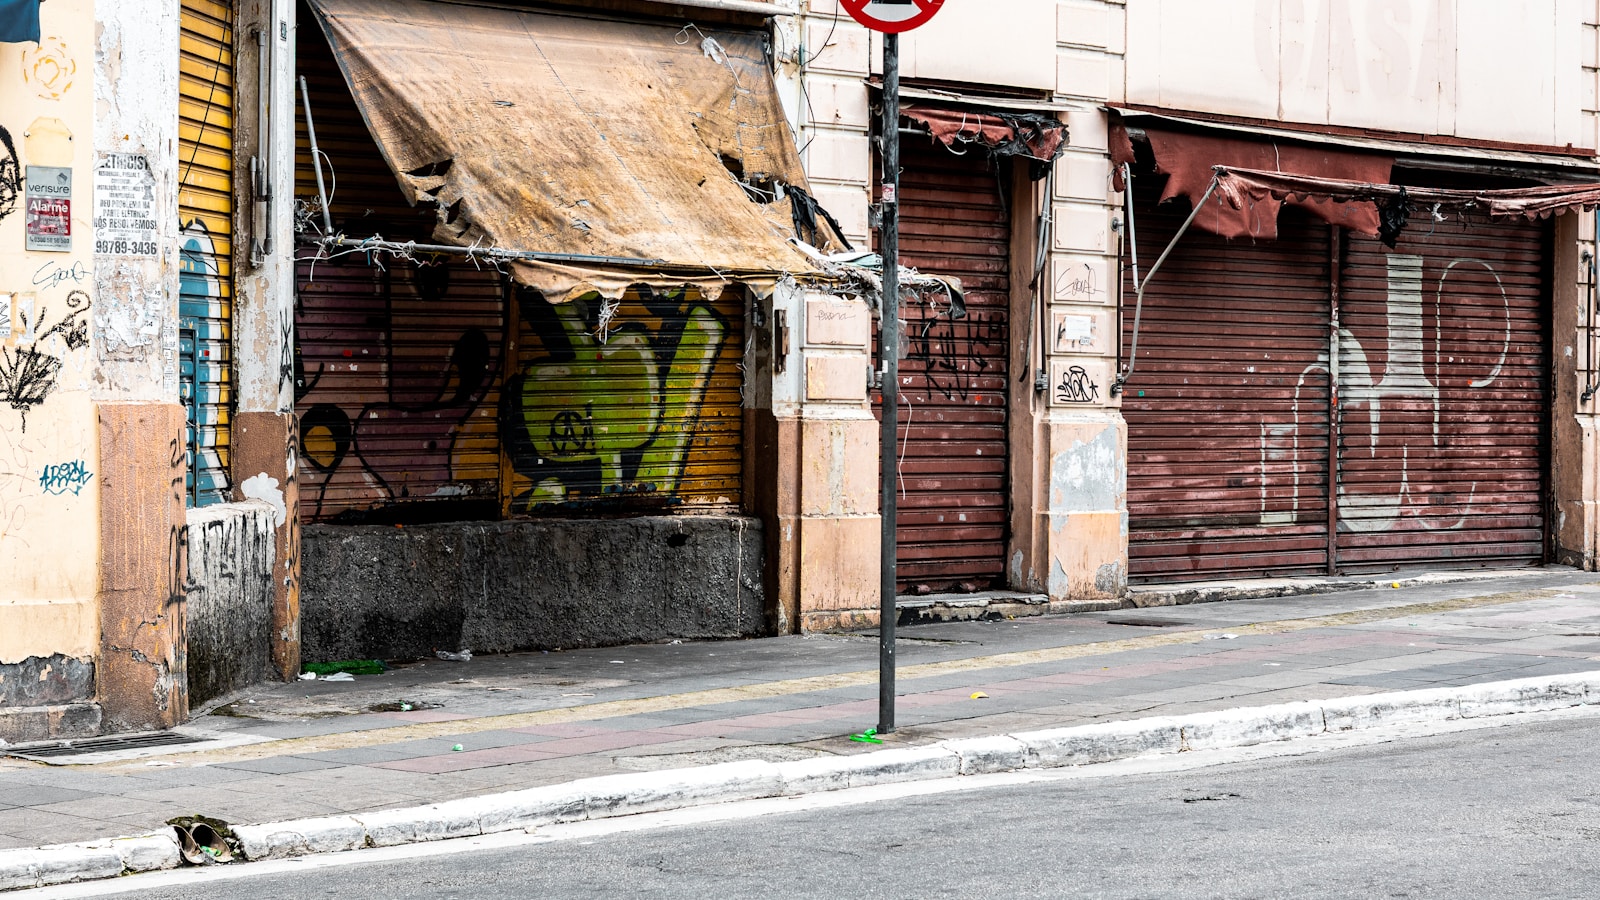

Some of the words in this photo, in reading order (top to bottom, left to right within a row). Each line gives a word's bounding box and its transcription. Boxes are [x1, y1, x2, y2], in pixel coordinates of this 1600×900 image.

[28, 184, 70, 194] verisure
[29, 200, 69, 213] Alarme
[94, 215, 107, 228] NÓS
[109, 218, 157, 230] RESOLVEMOS!
[95, 240, 158, 255] 98789-3436
